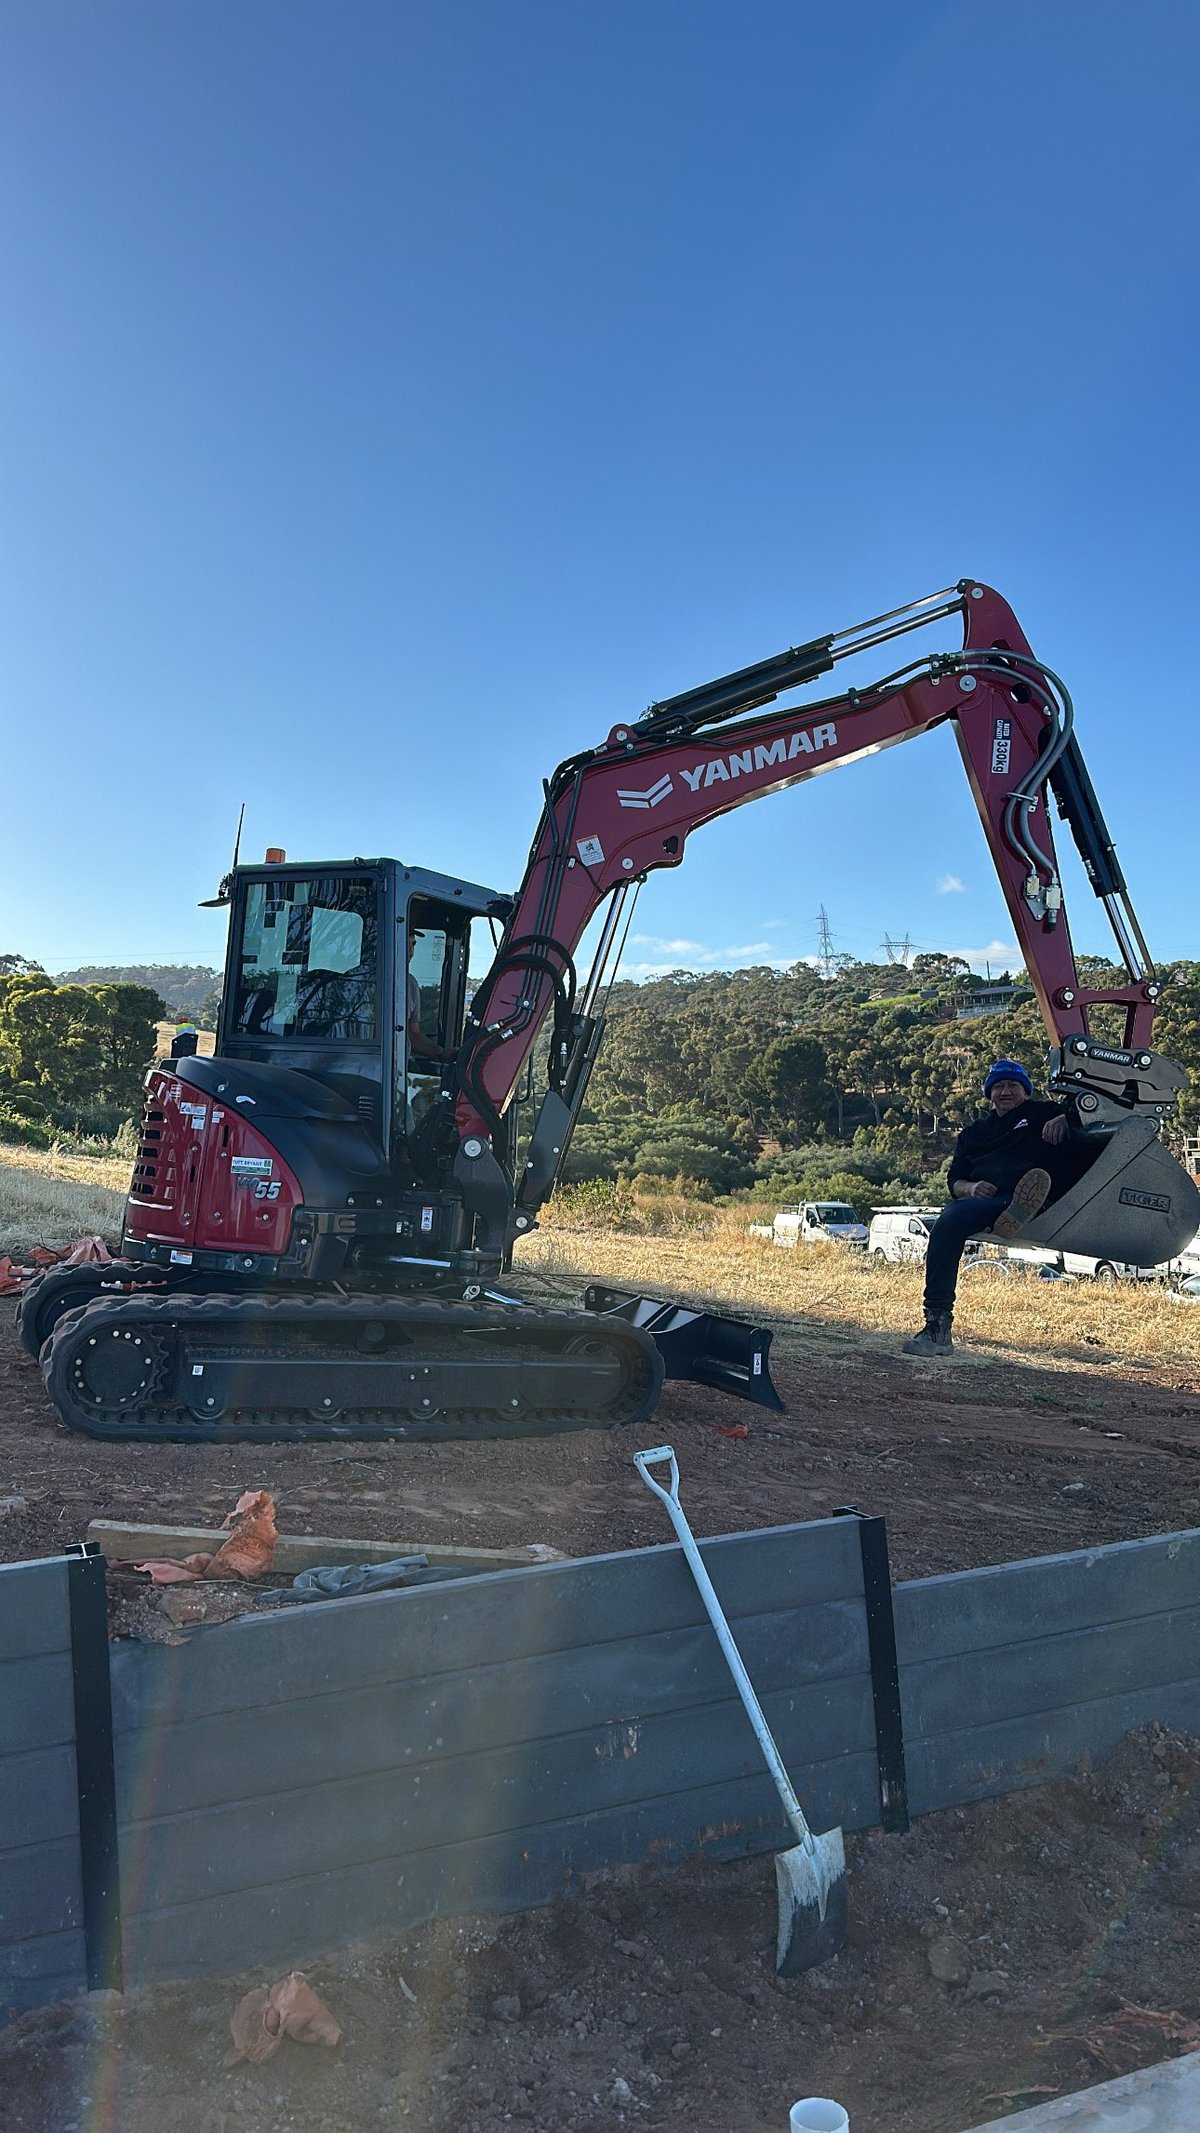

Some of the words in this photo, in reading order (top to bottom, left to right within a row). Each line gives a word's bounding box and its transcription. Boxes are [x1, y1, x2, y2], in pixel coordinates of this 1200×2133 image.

[679, 722, 838, 792] YANMAR
[993, 741, 1008, 773] 330kg
[1093, 1049, 1130, 1062] YANMAR
[1123, 1191, 1168, 1209] TIGER
